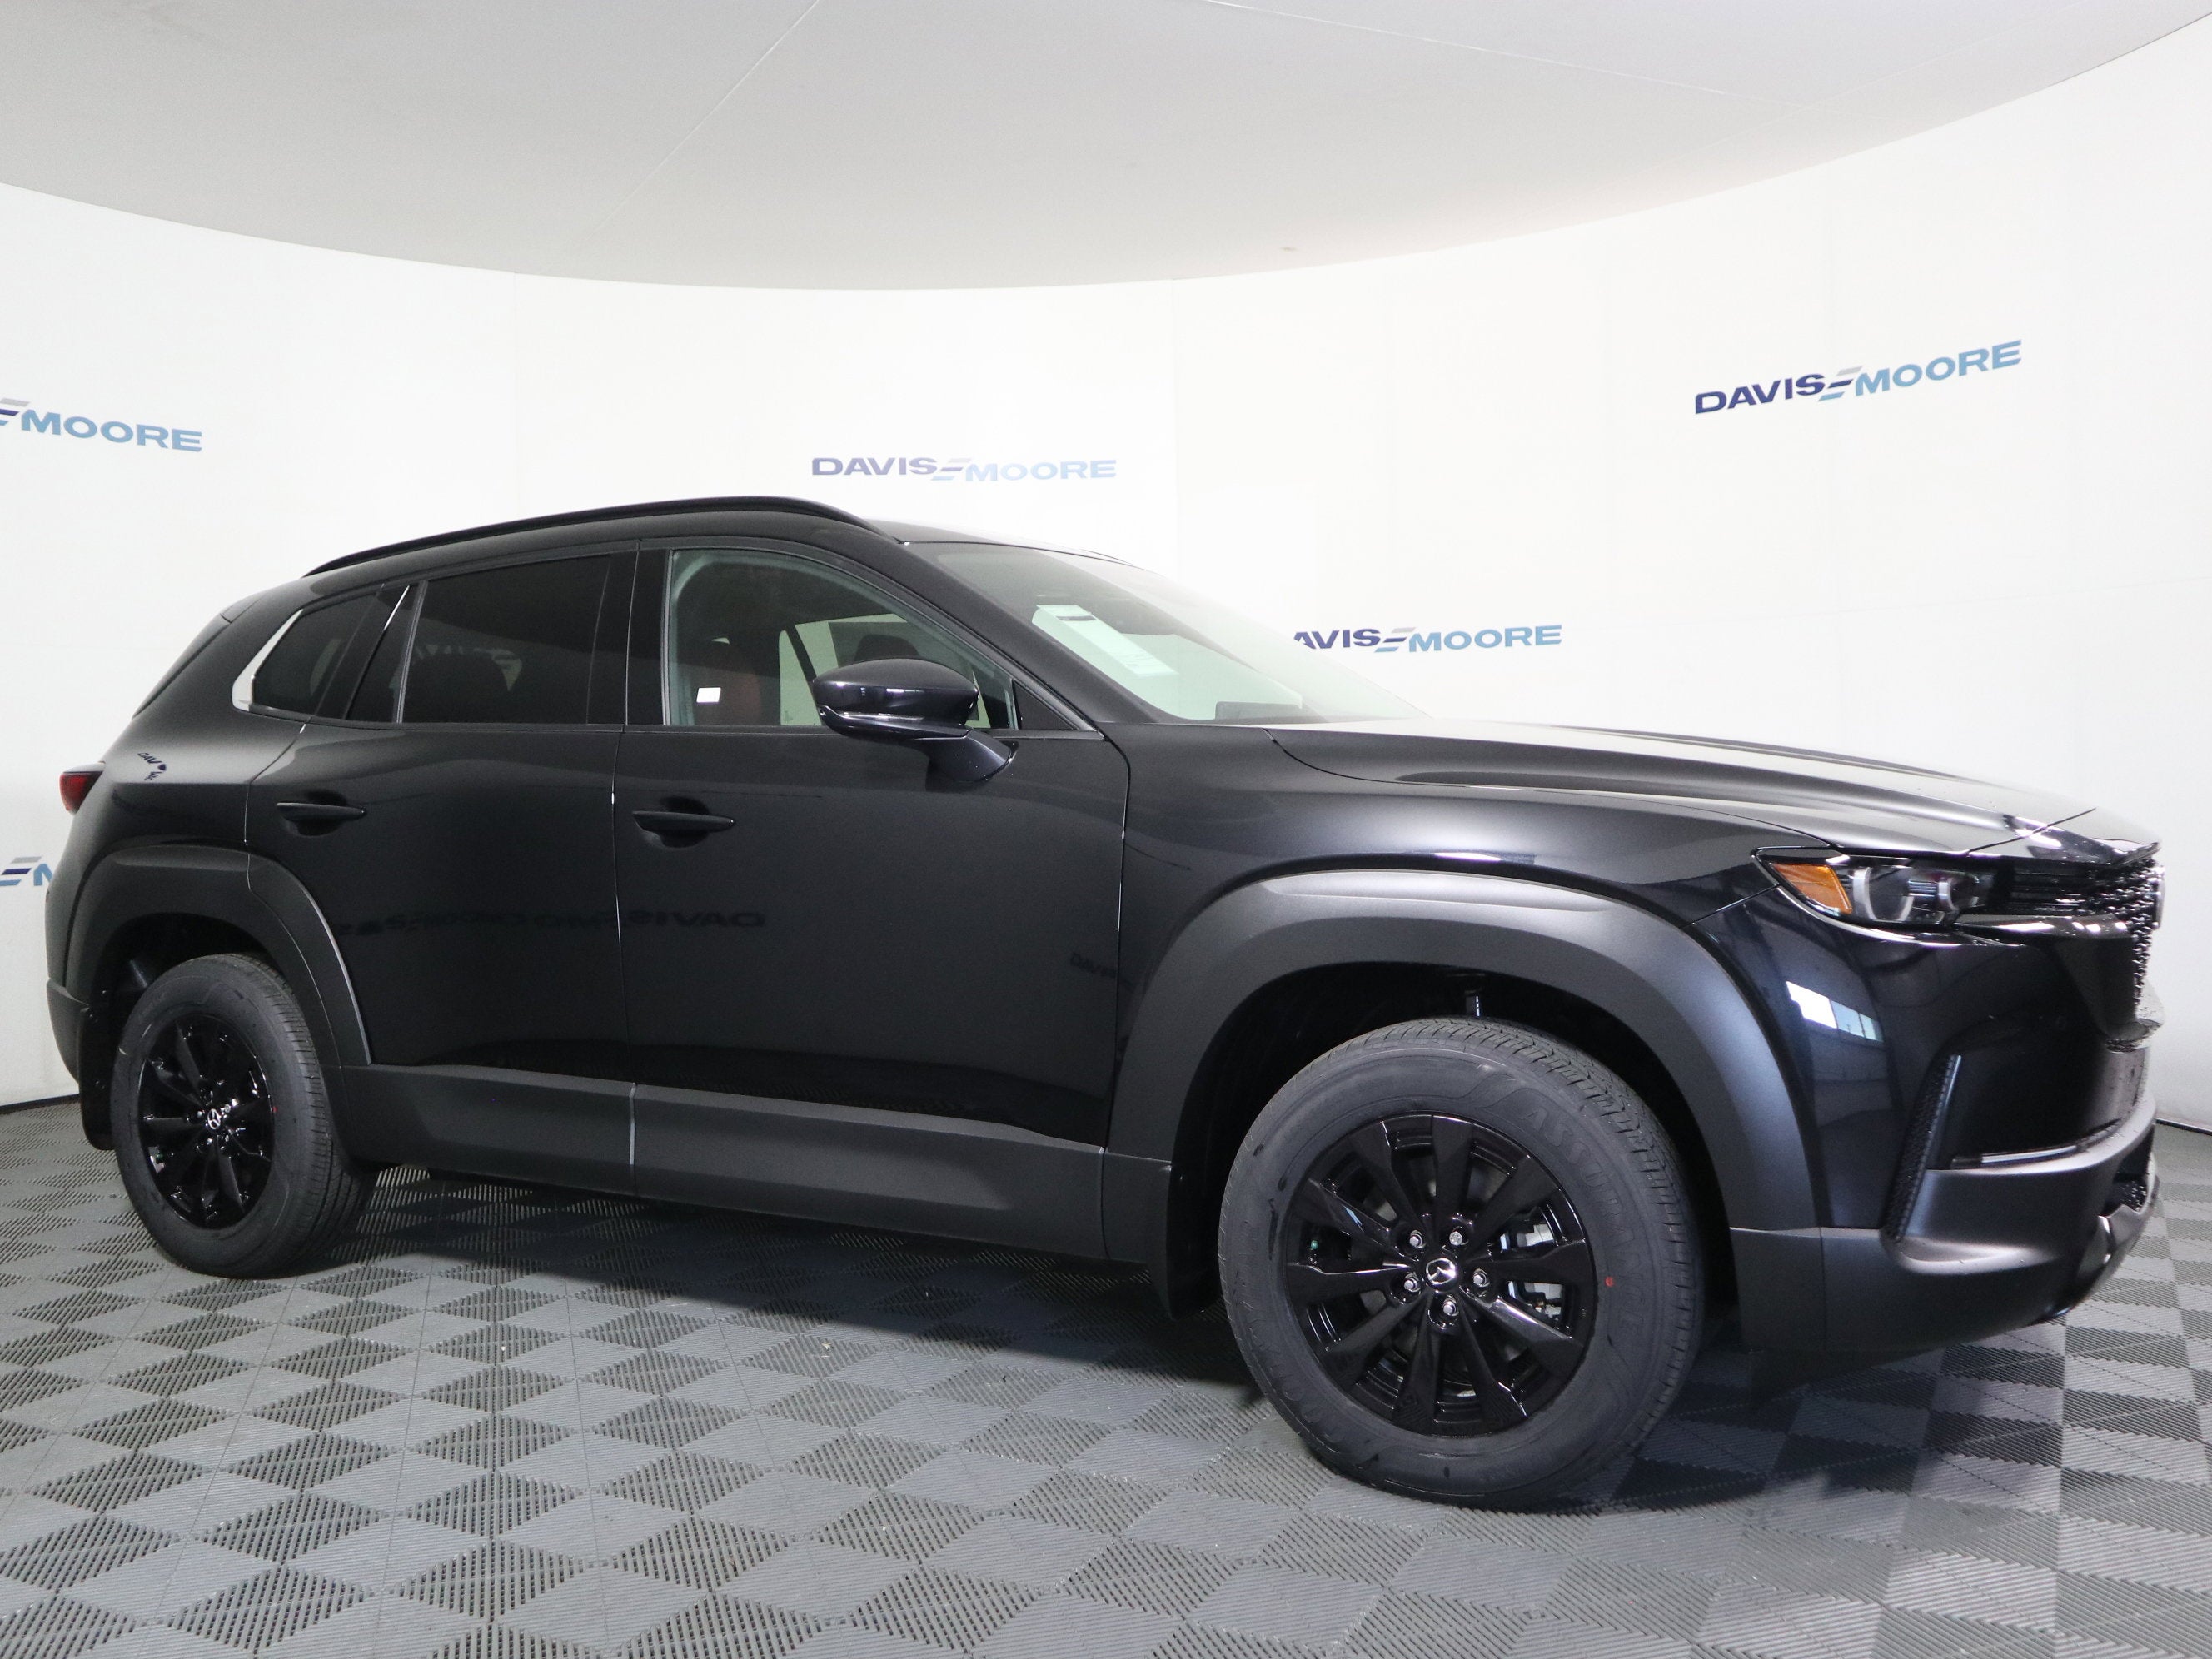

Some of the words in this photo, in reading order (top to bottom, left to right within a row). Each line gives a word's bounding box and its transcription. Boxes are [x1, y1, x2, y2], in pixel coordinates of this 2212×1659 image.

[1695, 373, 1826, 414] DAVIS
[1855, 339, 2021, 396] MOORE
[21, 409, 202, 452] MOORE
[812, 457, 938, 476] DAVIS
[965, 460, 1117, 481] MOORE
[1293, 627, 1381, 650] AVIS
[1409, 625, 1562, 652] MOORE
